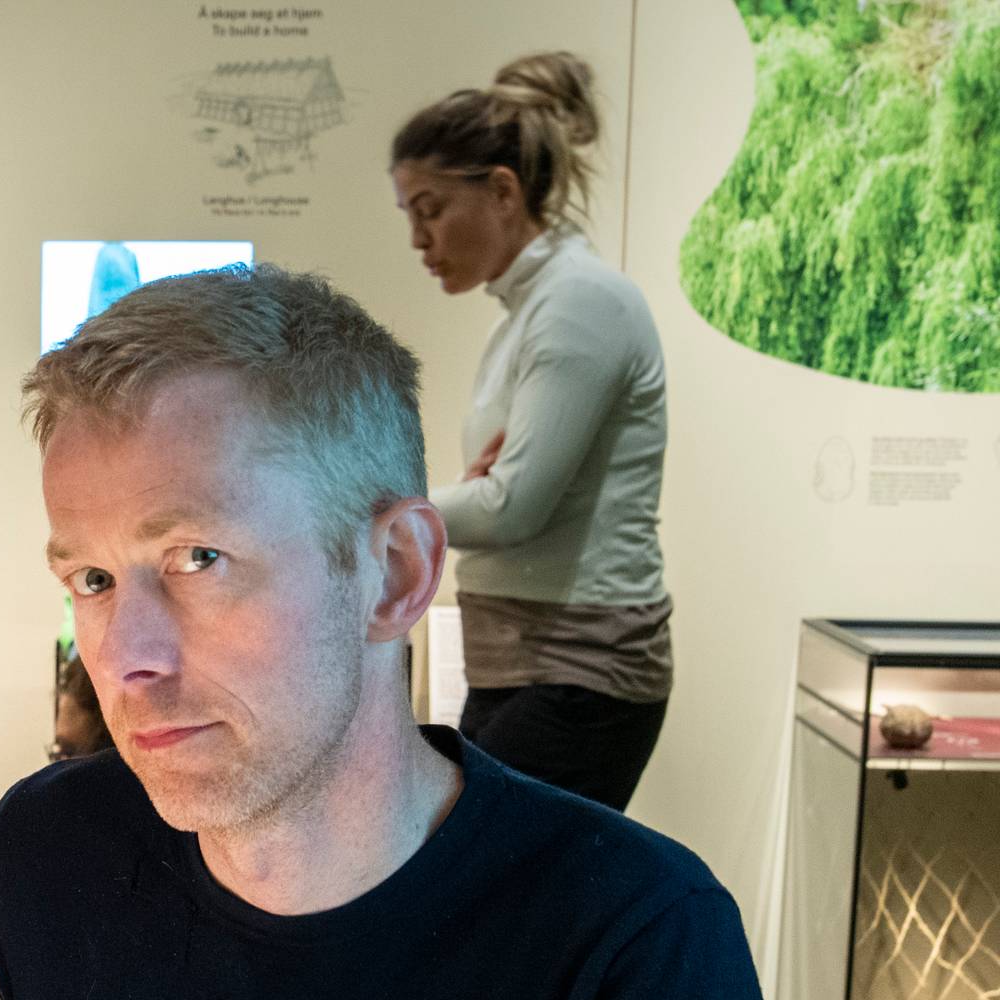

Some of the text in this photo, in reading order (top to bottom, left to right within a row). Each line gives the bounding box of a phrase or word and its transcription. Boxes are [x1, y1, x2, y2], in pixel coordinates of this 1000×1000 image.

[198, 4, 324, 21] Å skape seg et hjem
[212, 23, 310, 37] To build a home
